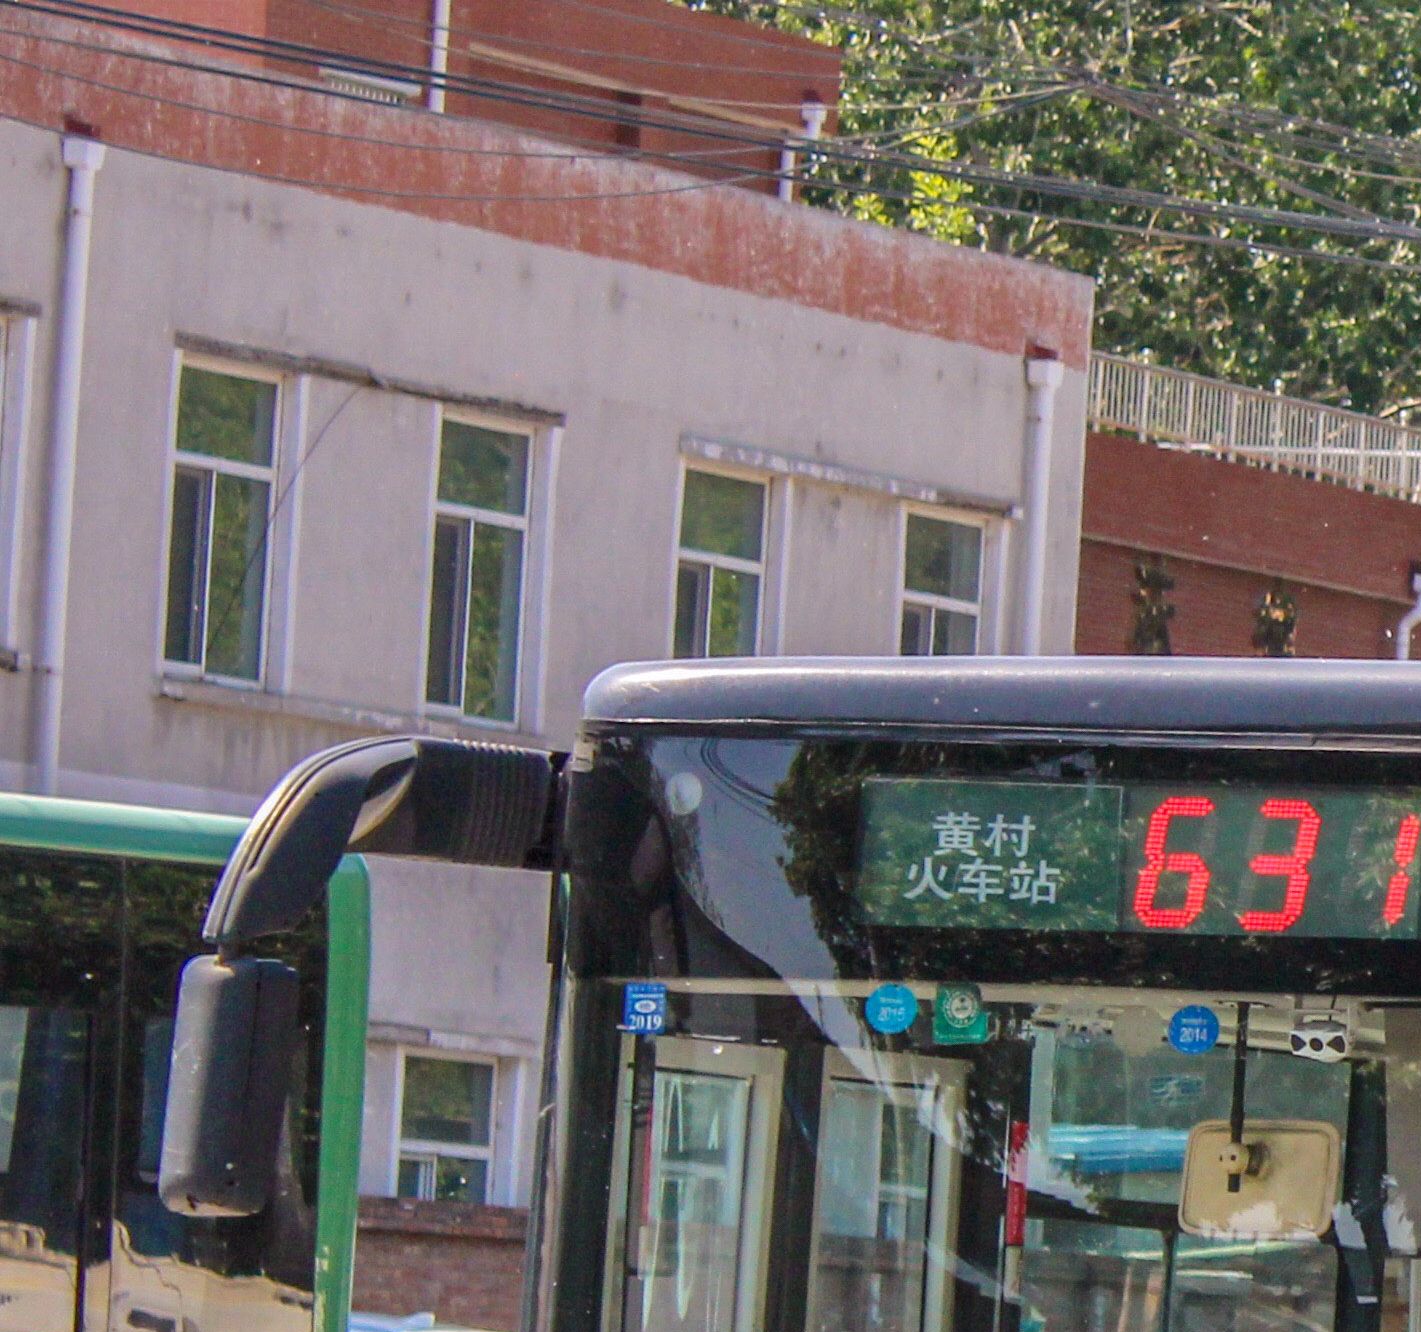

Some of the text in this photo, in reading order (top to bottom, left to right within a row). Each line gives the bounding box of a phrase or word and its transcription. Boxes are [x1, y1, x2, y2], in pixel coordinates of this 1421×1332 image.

[932, 811, 1036, 858] 黄村
[902, 856, 1061, 905] 火车站
[1132, 795, 1421, 933] 631
[628, 1014, 662, 1031] 2019
[1179, 1026, 1208, 1043] 2014
